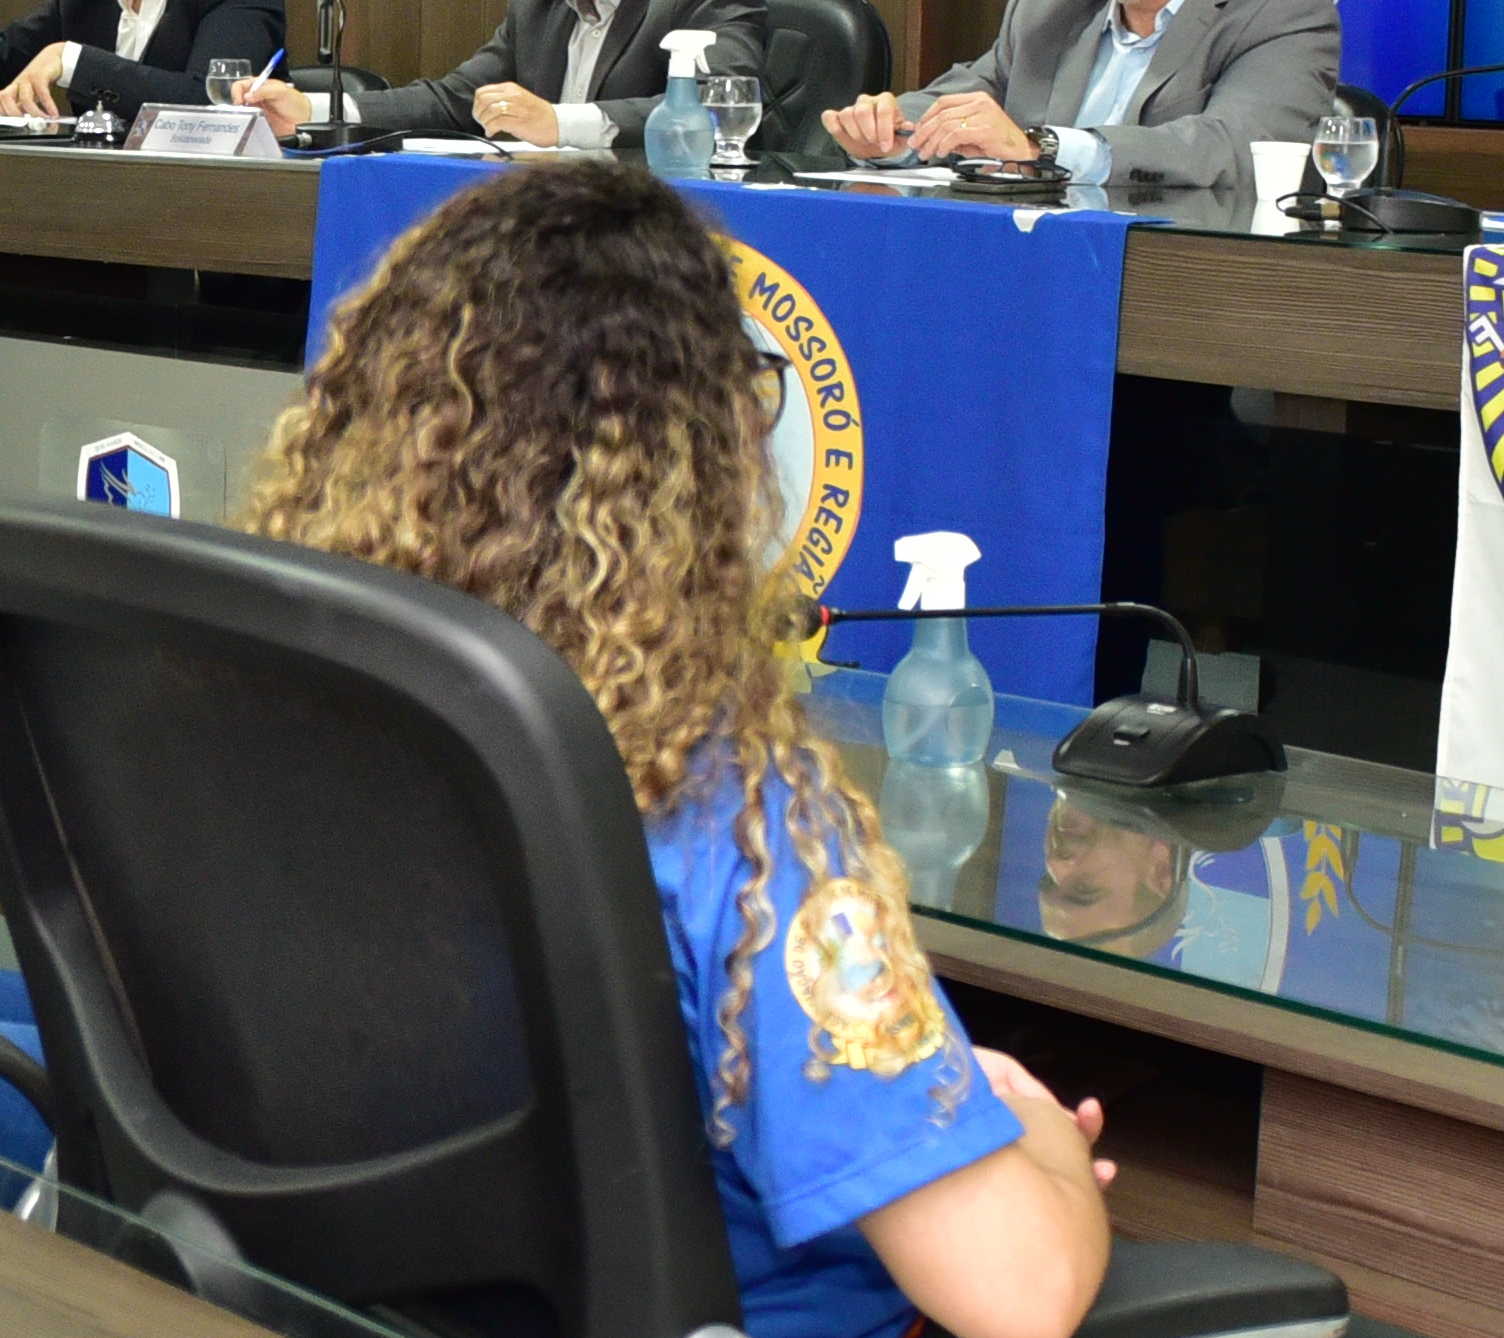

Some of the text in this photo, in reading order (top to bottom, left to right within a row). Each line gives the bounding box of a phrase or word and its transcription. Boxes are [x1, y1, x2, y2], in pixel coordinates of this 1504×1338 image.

[748, 271, 860, 596] MOSSORÓ E REGIÃ
